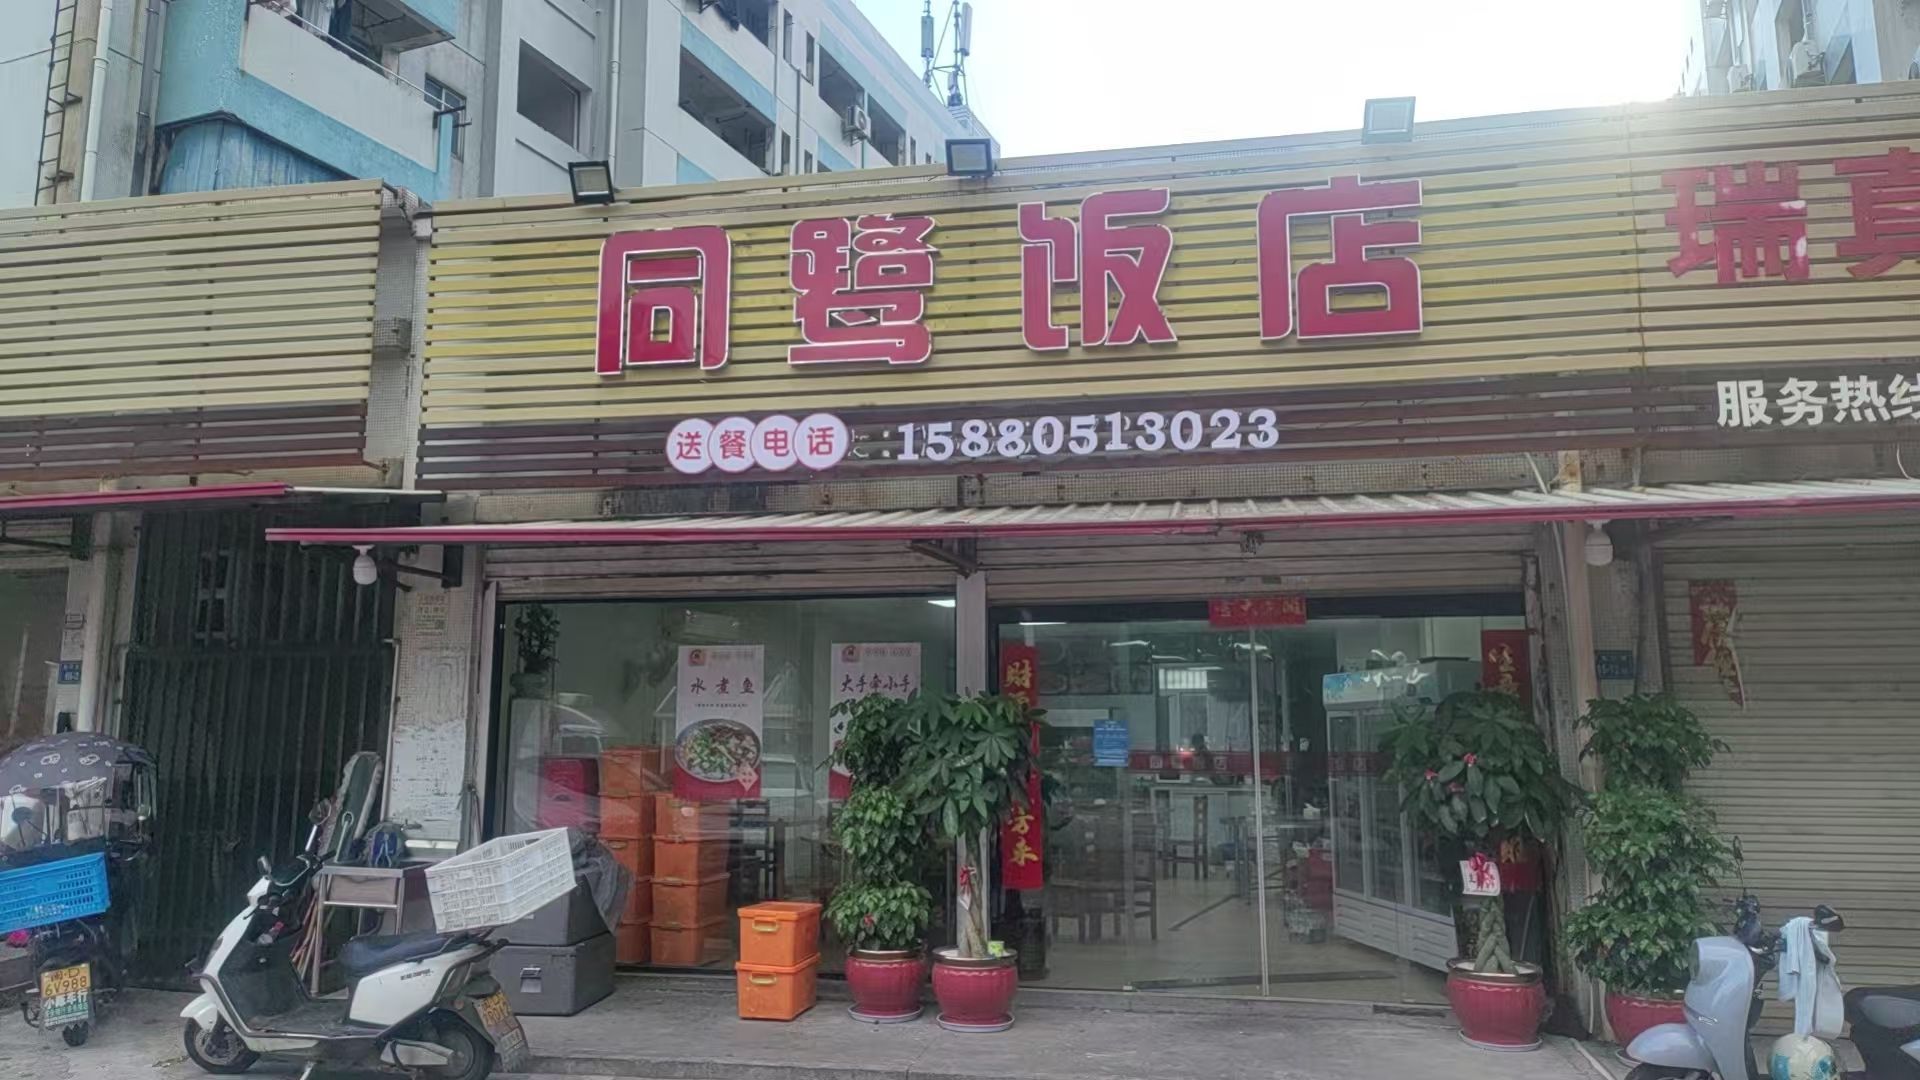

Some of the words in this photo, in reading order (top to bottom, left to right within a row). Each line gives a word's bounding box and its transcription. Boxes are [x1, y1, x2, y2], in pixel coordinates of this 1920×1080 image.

[595, 173, 1423, 375] 同鹭饭店
[673, 424, 838, 462] 送餐电话
[689, 676, 756, 695] 水煮鱼
[44, 975, 88, 996] 6V988
